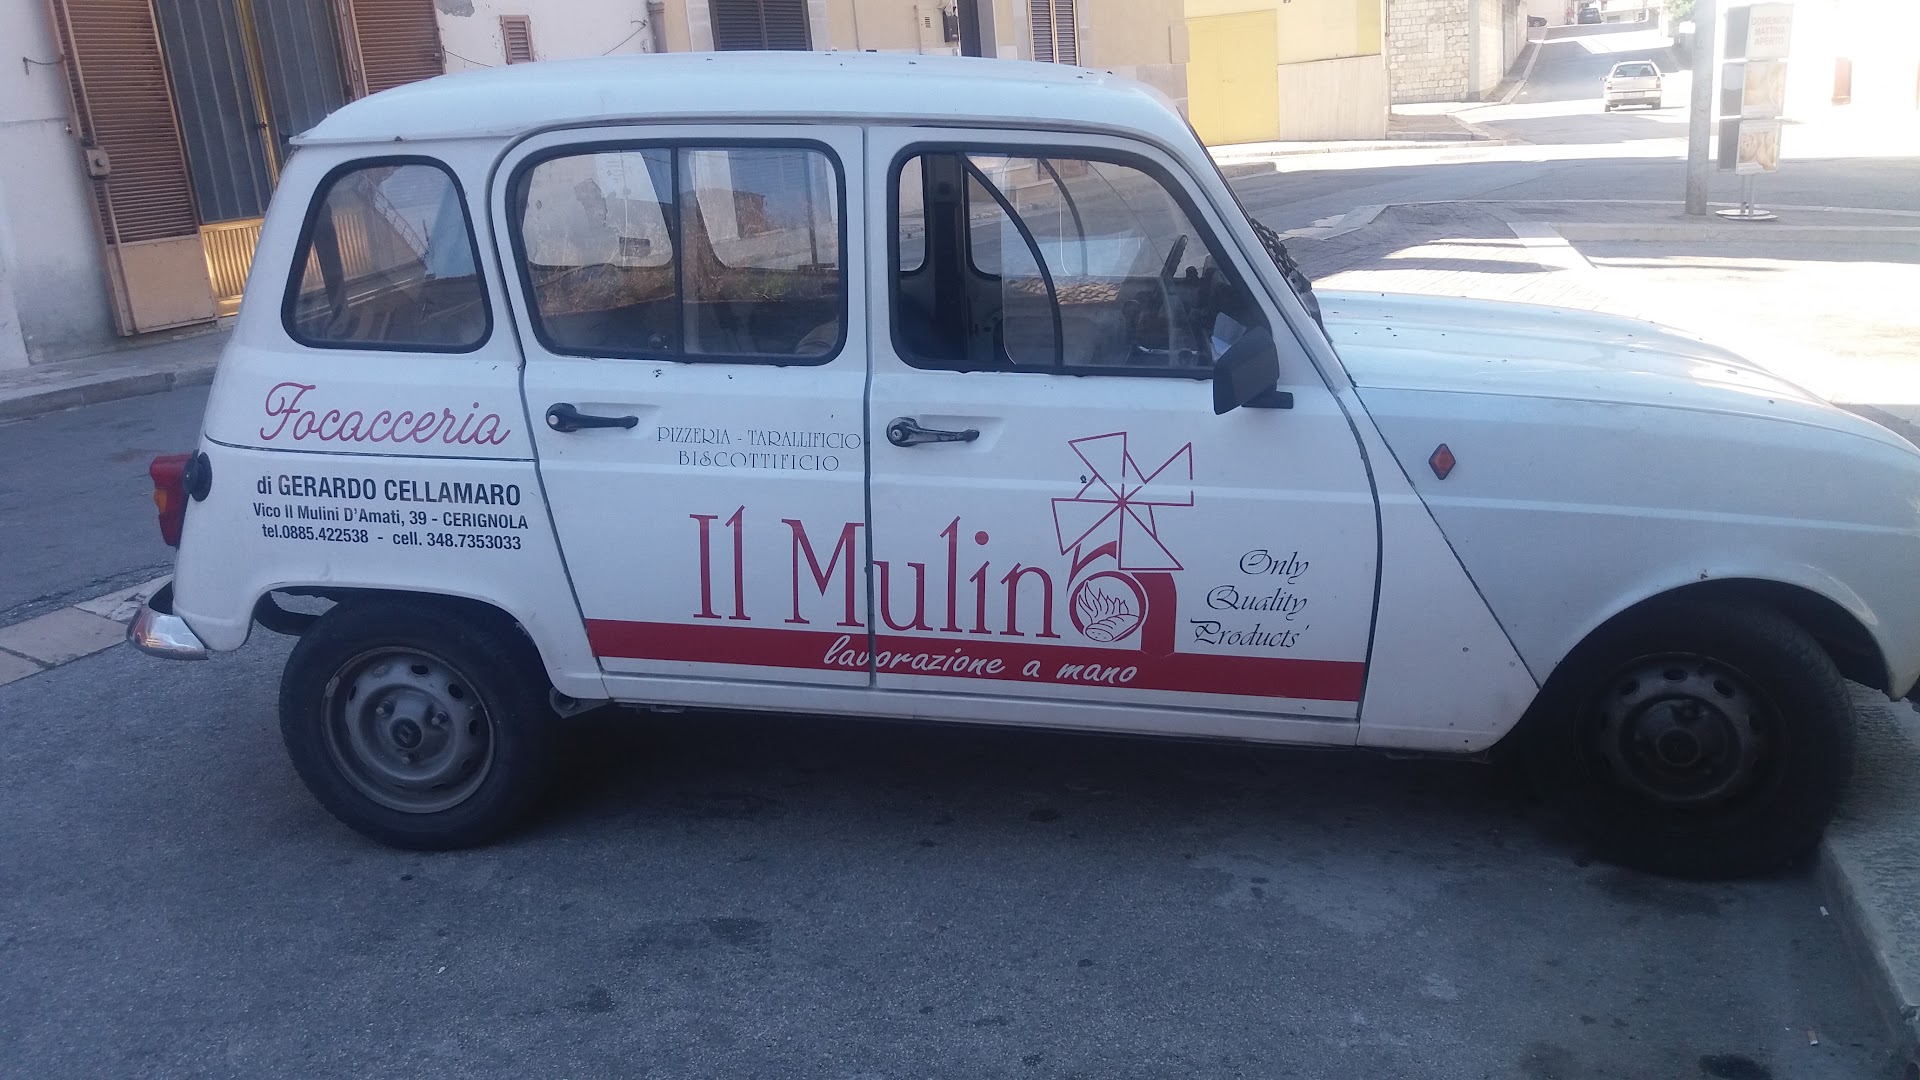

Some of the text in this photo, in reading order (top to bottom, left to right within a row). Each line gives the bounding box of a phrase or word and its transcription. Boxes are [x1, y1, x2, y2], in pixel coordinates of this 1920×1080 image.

[259, 381, 511, 445] Focacceria
[657, 426, 731, 445] PIZZERIA
[747, 429, 861, 449] TARALLIFICIO
[678, 450, 839, 472] BISCOTTIFICIO
[257, 474, 521, 506] di GERARDO CELLAMARO
[253, 503, 281, 518] Vico
[298, 506, 340, 522] Mulini
[409, 510, 428, 526] 39
[443, 512, 529, 530] CERIGNOLA
[262, 524, 369, 544] tel.0885.422538
[392, 532, 422, 547] cell.
[427, 532, 522, 550] 348.7353033
[689, 504, 752, 621] Il
[1239, 549, 1310, 585] Only
[1206, 584, 1308, 621] Quality
[823, 635, 1138, 684] lavorazione a mano
